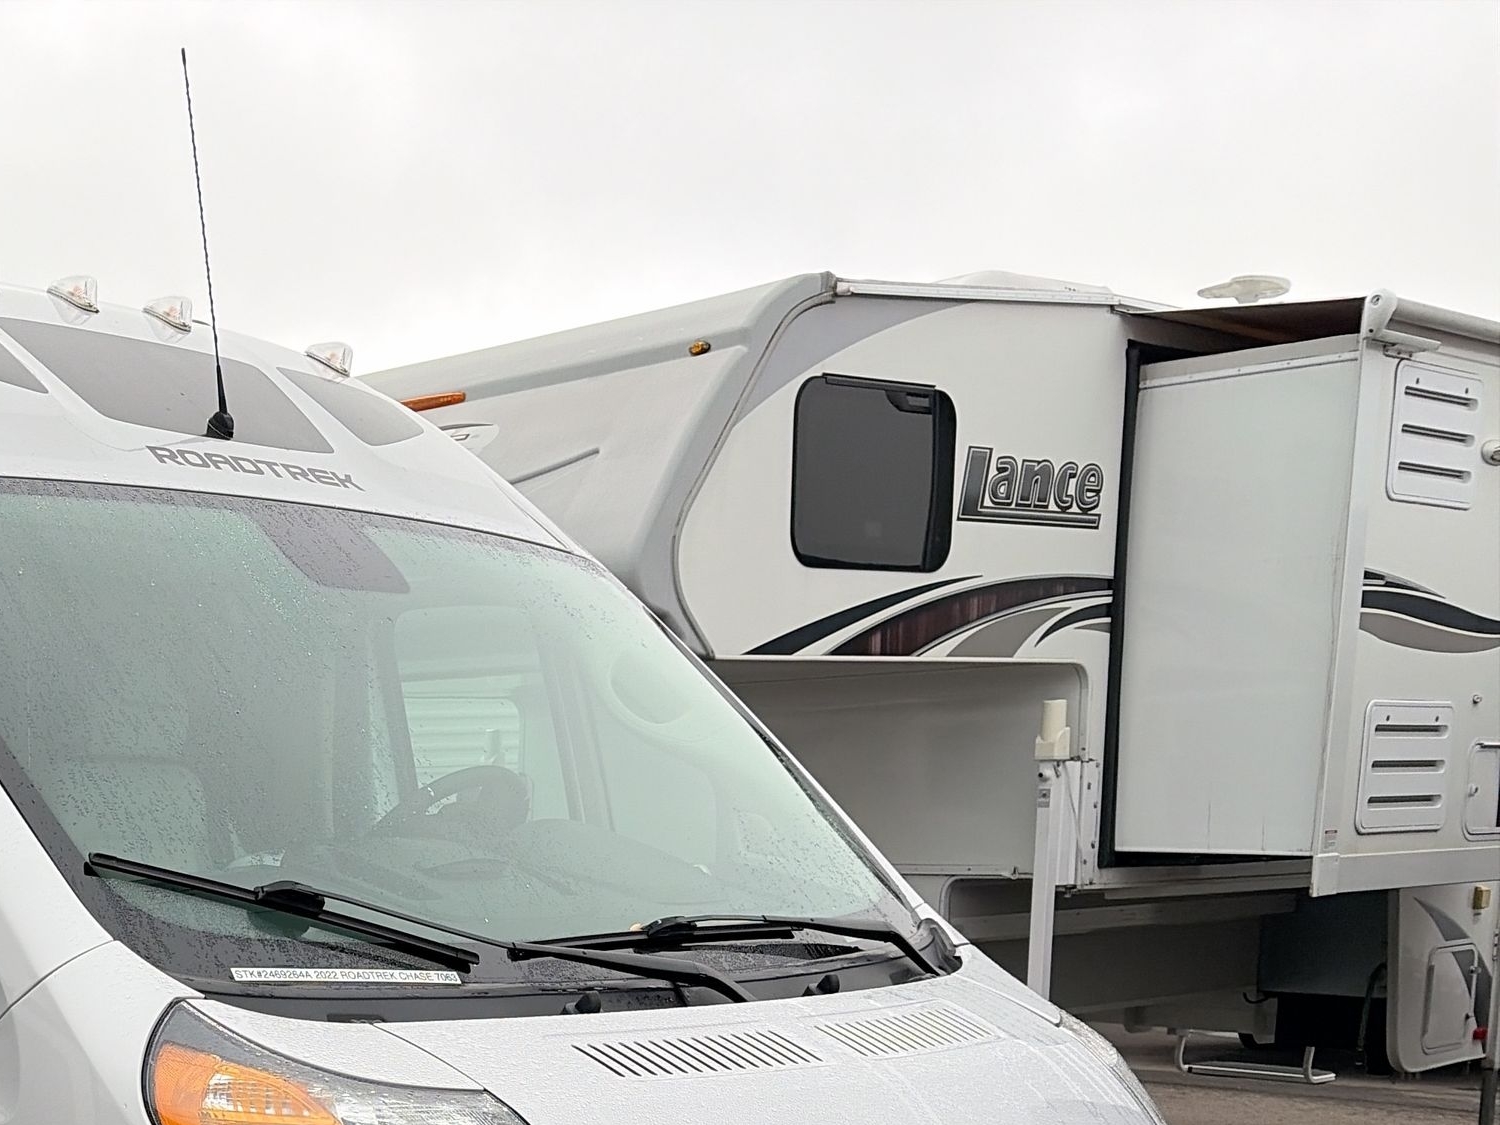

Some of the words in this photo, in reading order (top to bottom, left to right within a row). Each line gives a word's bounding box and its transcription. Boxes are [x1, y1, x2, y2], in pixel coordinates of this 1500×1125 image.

[146, 445, 366, 492] ROADTREK
[957, 445, 1104, 530] Lance
[314, 970, 339, 979] 2022
[340, 970, 398, 981] ROADTREK
[399, 972, 434, 981] CHASE
